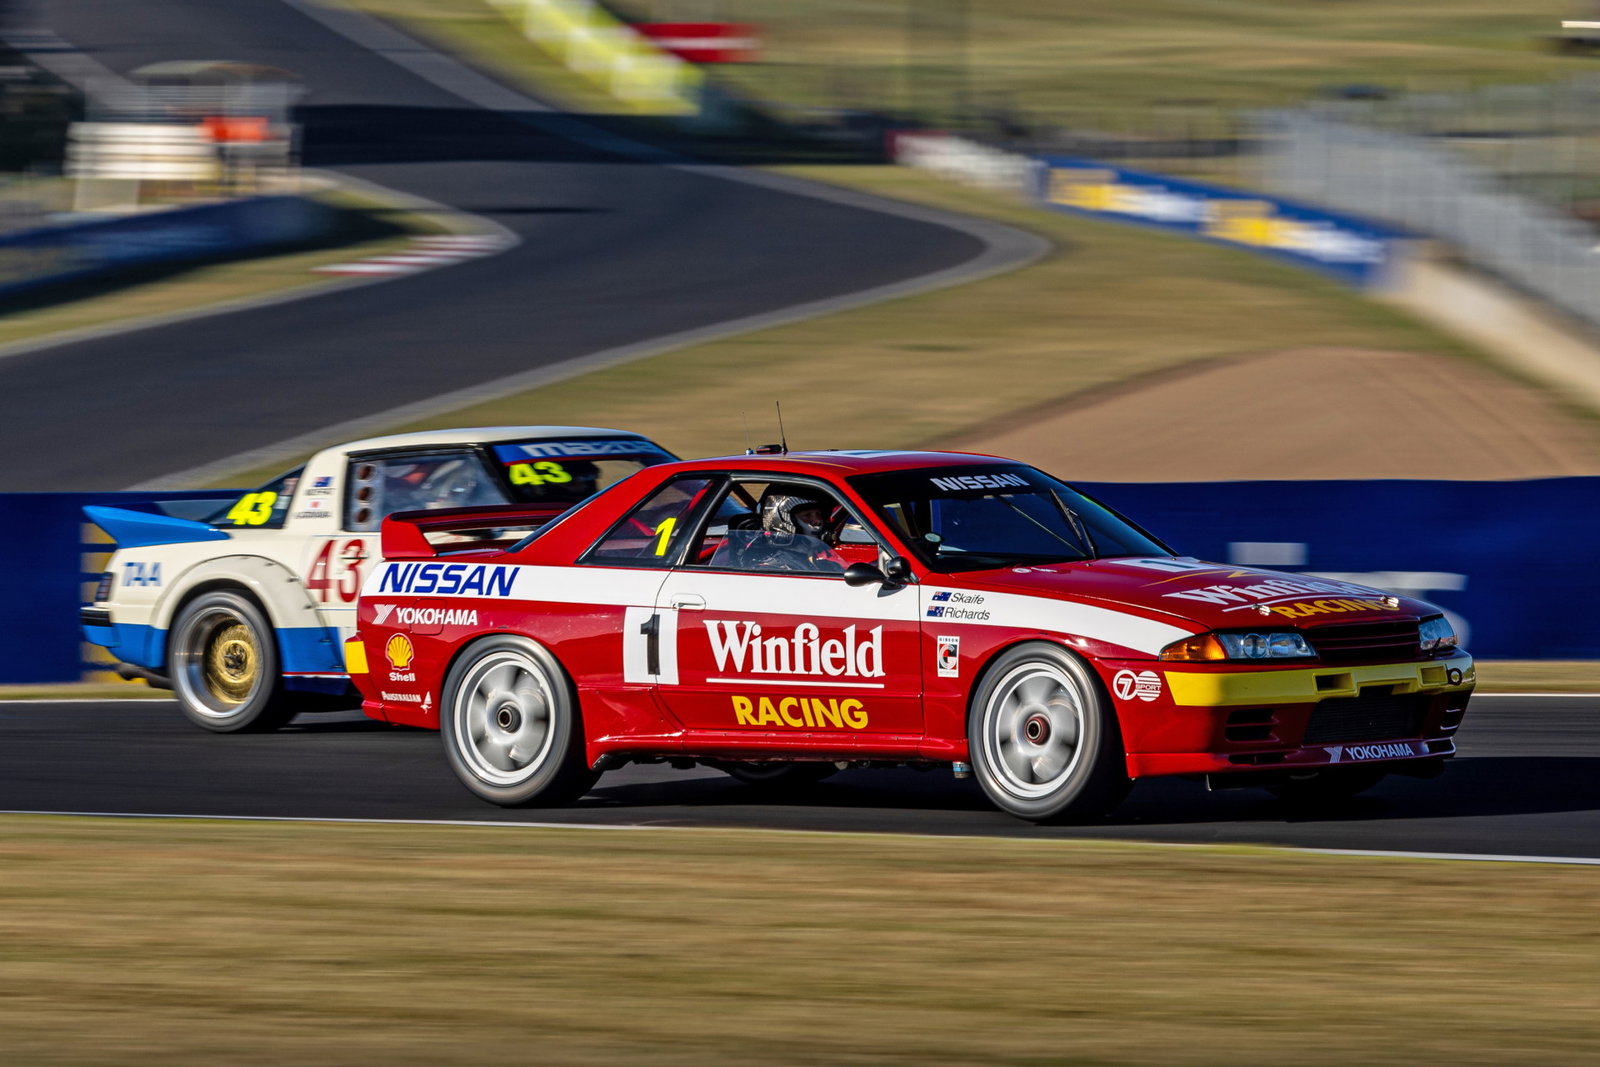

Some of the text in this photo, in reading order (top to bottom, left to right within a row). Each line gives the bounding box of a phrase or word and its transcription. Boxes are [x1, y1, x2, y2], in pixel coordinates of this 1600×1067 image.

[509, 461, 573, 485] 43
[930, 473, 1030, 491] NISSAN
[227, 491, 277, 526] 43
[655, 517, 677, 556] 1
[304, 539, 366, 602] 43
[379, 563, 521, 597] NISSAN
[950, 592, 985, 605] Skaife
[1270, 597, 1399, 619] RACING
[396, 607, 478, 626] YOKOHAMA
[944, 606, 991, 621] Richards
[640, 613, 661, 676] 1
[702, 619, 886, 678] Winfield
[388, 672, 416, 682] Shell
[731, 695, 869, 729] RACING
[1345, 743, 1415, 760] YOKOHAMA
